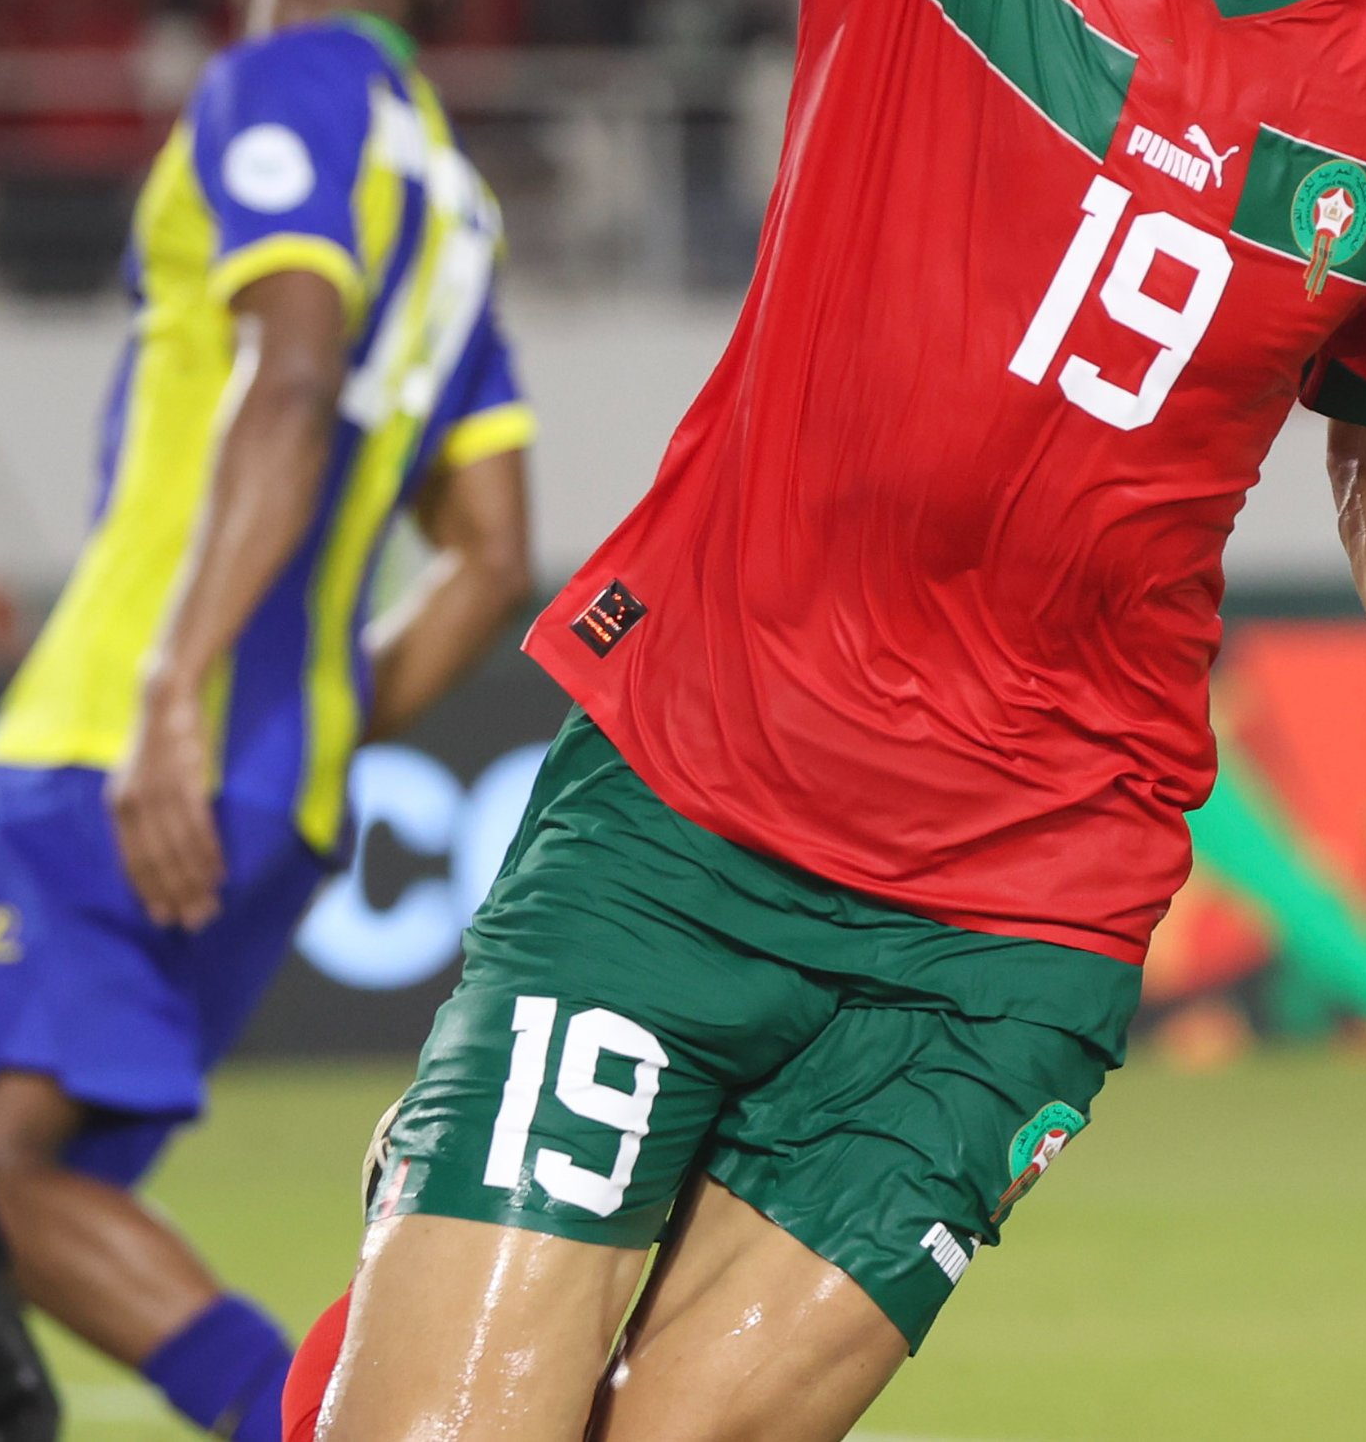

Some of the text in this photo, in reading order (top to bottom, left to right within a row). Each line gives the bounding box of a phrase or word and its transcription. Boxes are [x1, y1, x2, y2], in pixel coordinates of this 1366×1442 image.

[1126, 124, 1211, 192] PUMA
[1007, 174, 1234, 431] 19
[482, 995, 670, 1218] 19
